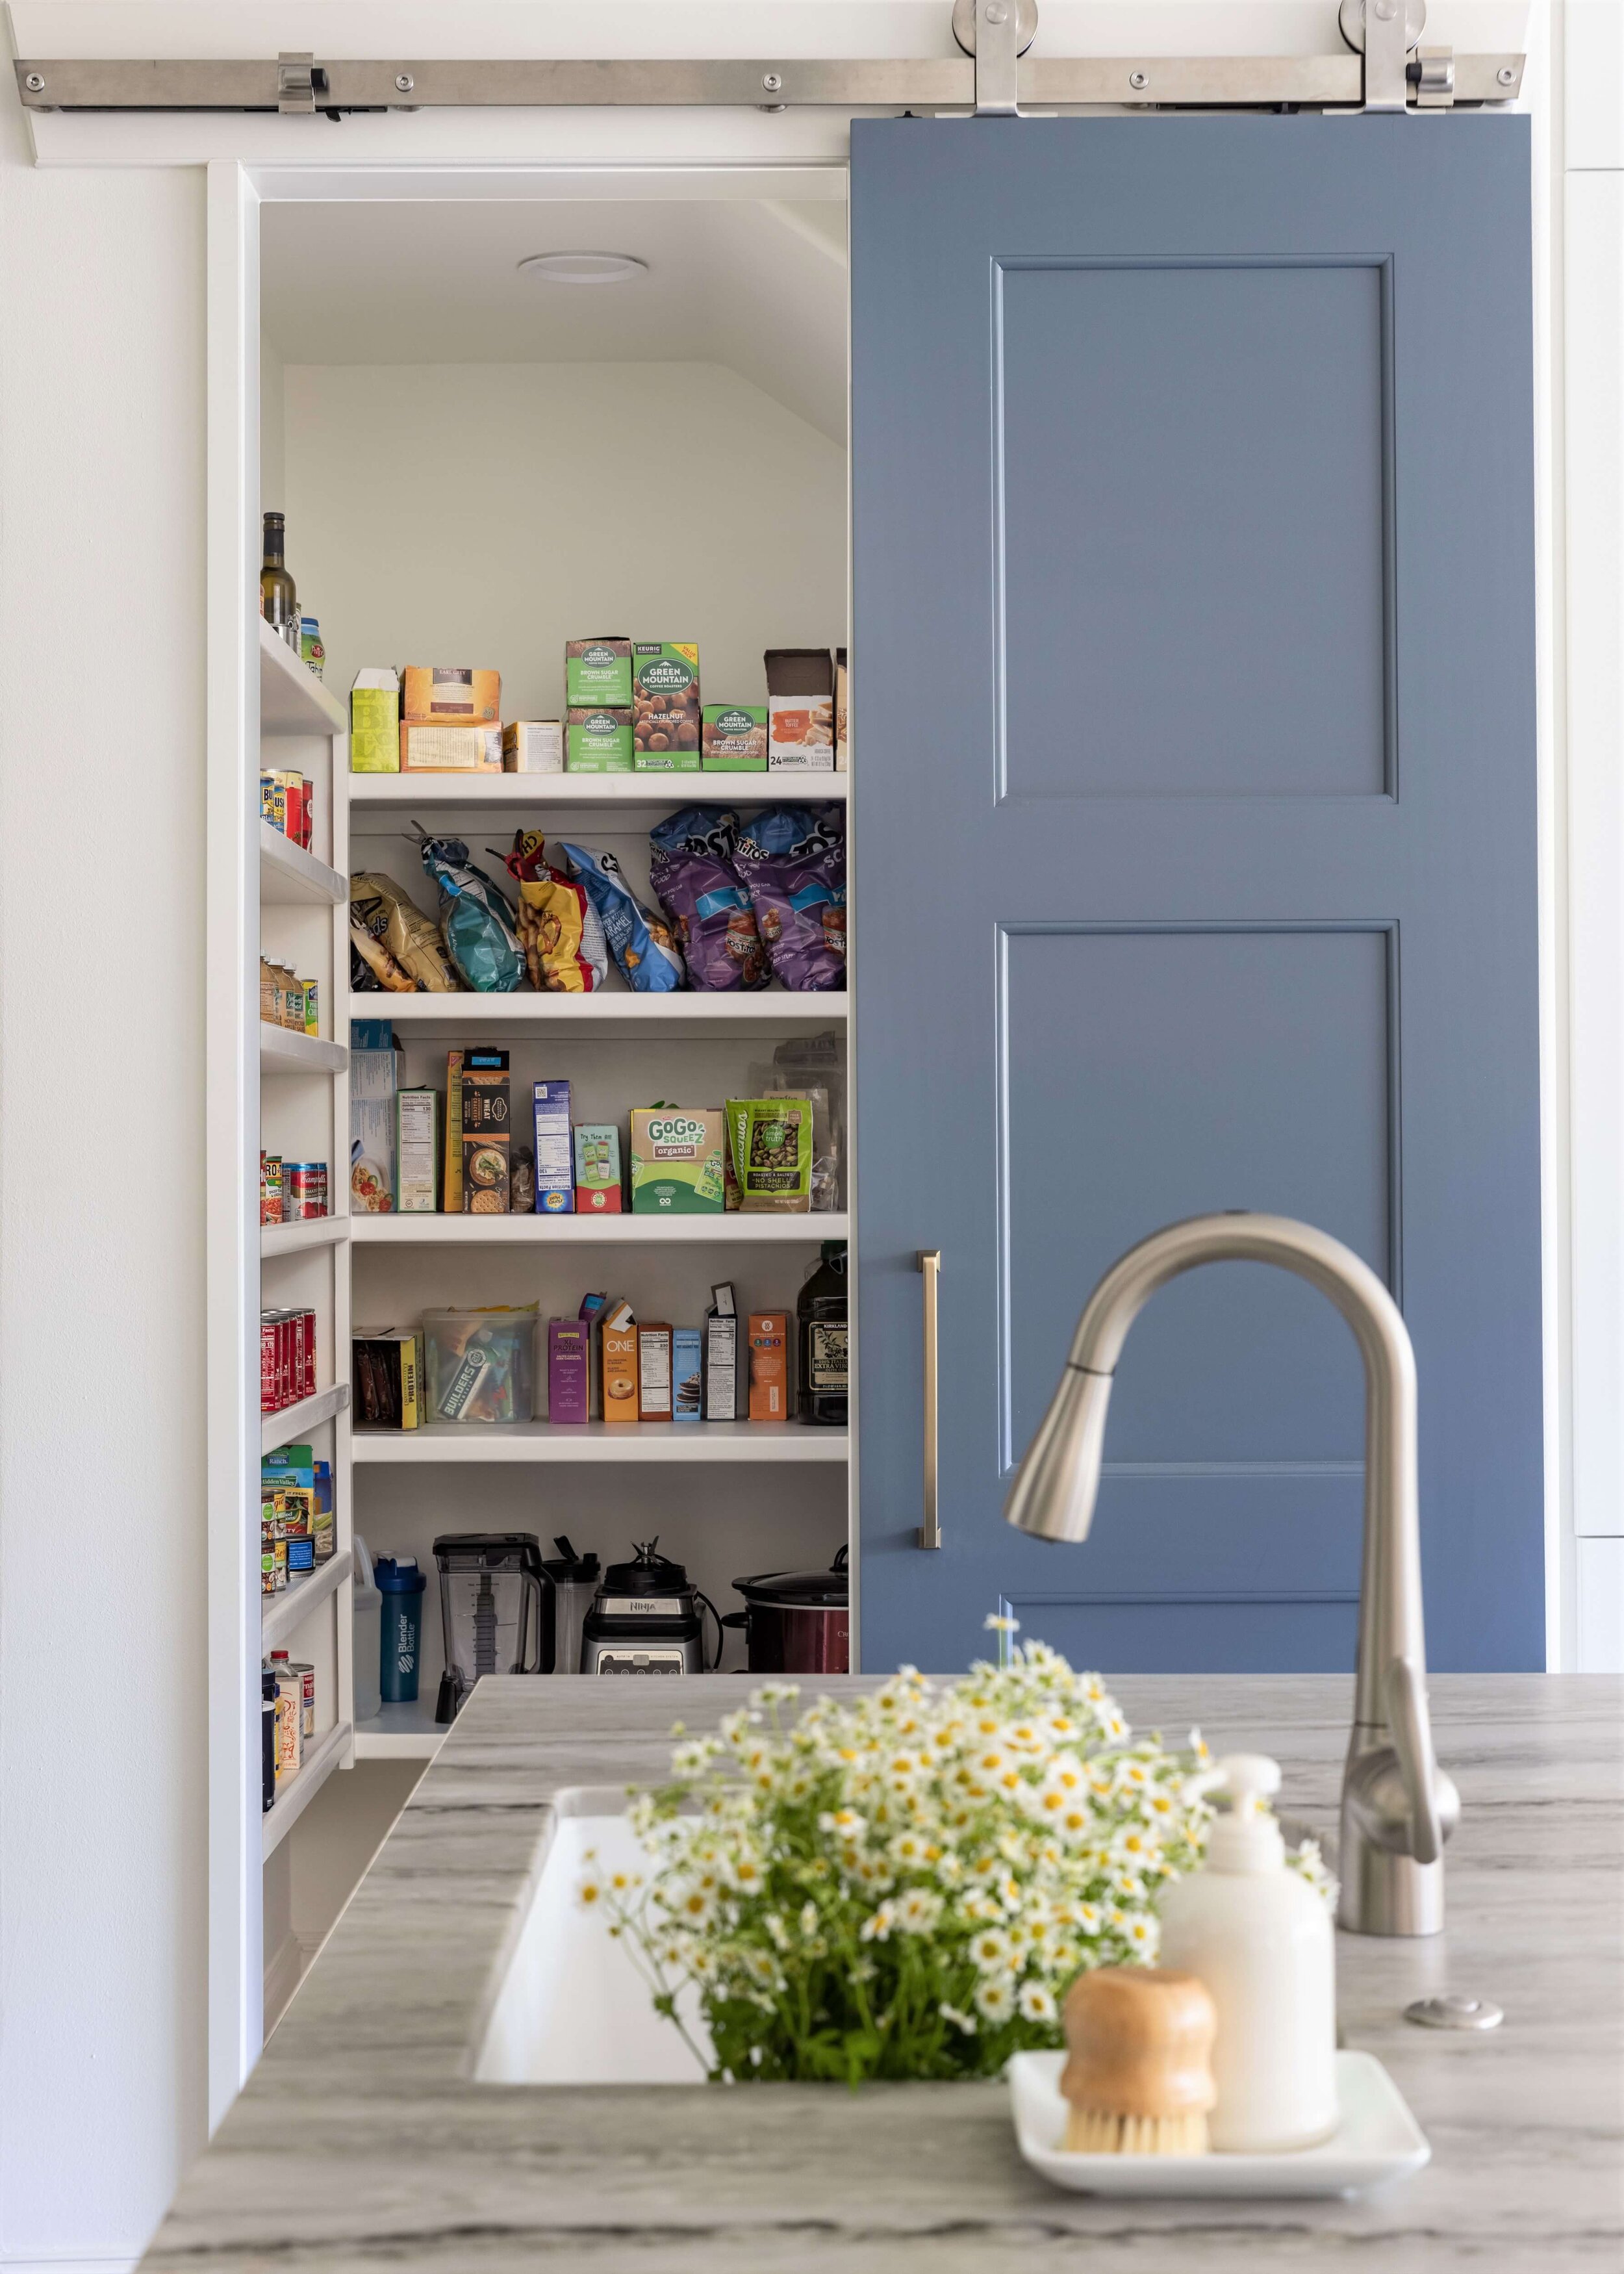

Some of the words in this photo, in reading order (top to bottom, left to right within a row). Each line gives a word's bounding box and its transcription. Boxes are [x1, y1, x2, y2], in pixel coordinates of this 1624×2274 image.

[681, 650, 693, 659] PACK
[683, 646, 696, 657] VALUE
[770, 756, 782, 765] 24
[657, 1147, 692, 1156] organic
[607, 1340, 635, 1351] ONE
[444, 1365, 476, 1417] BUILDERS
[630, 1602, 656, 1611] NINJA
[399, 1614, 408, 1653] Blender
[407, 1622, 415, 1652] Bottle
